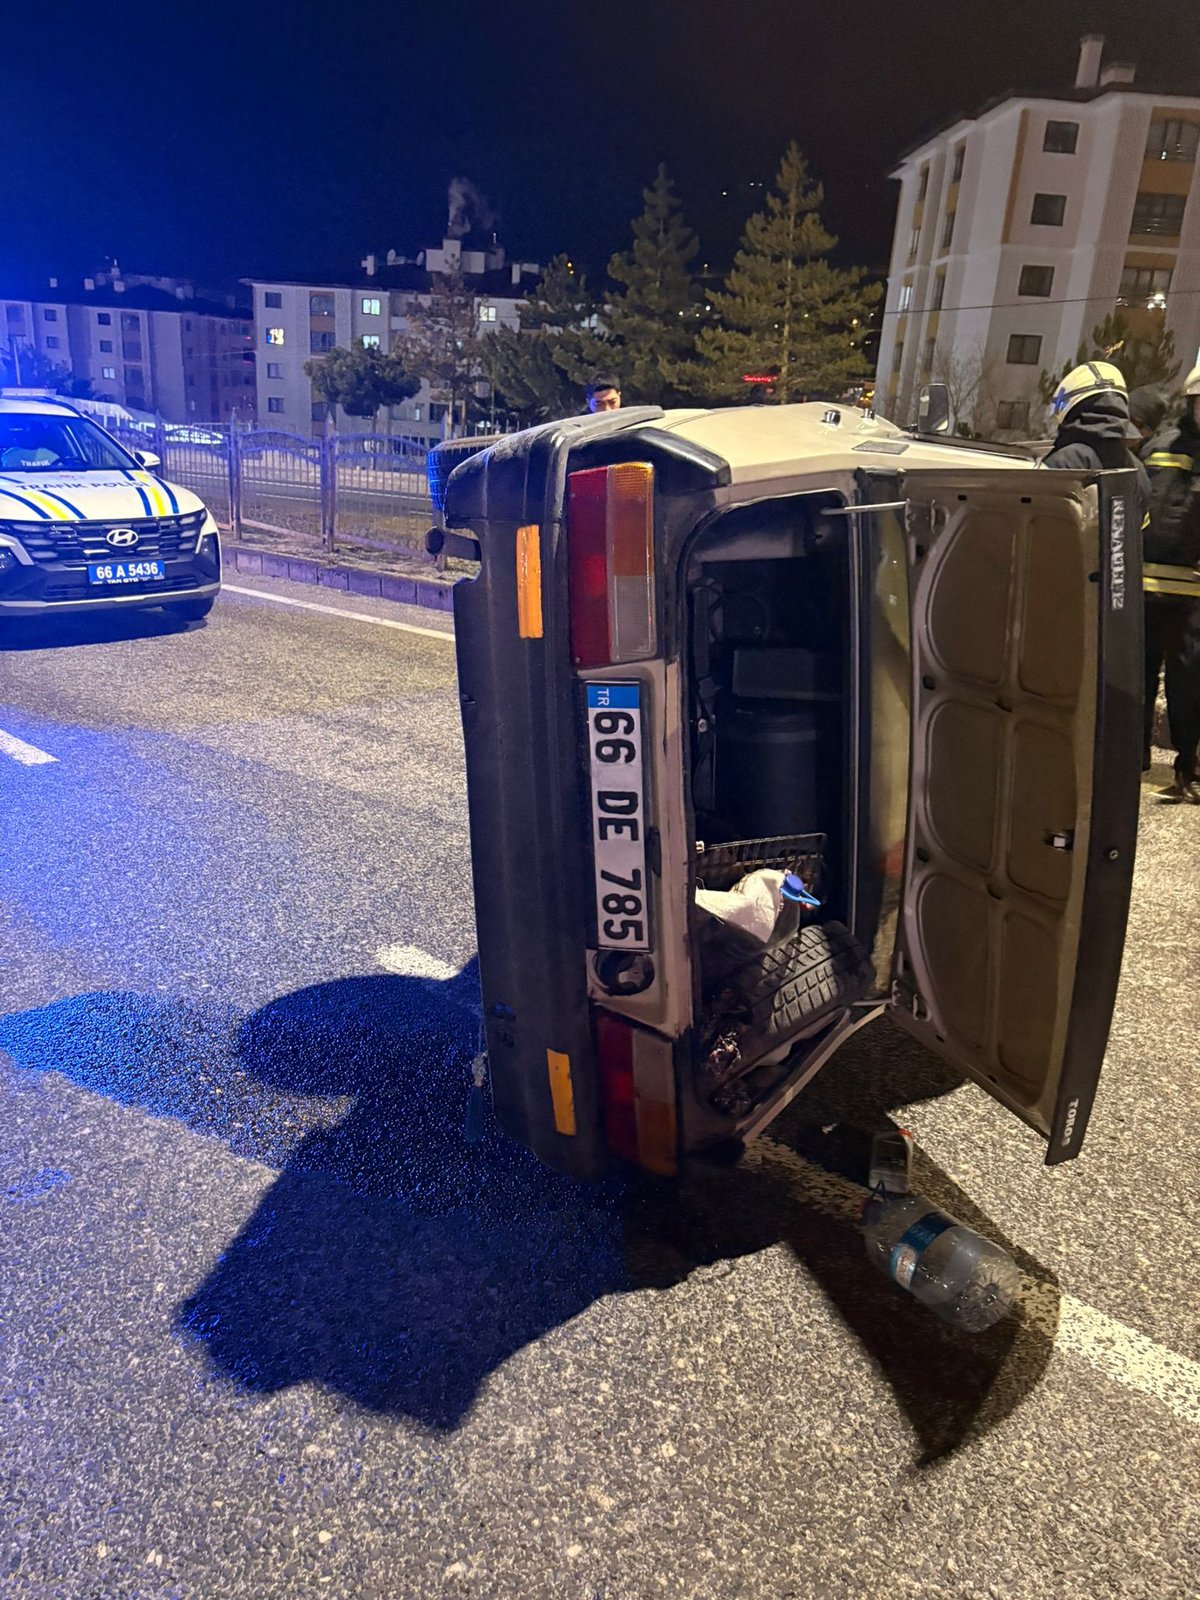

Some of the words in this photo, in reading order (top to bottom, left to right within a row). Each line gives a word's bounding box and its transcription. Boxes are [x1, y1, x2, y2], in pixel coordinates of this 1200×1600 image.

[96, 566, 112, 579] 66
[116, 565, 126, 577] A
[128, 562, 158, 576] 5436
[597, 688, 609, 706] TR
[594, 711, 636, 764] 66
[597, 790, 639, 842] DE
[600, 868, 644, 942] 785
[1062, 1098, 1079, 1146] TOROS
